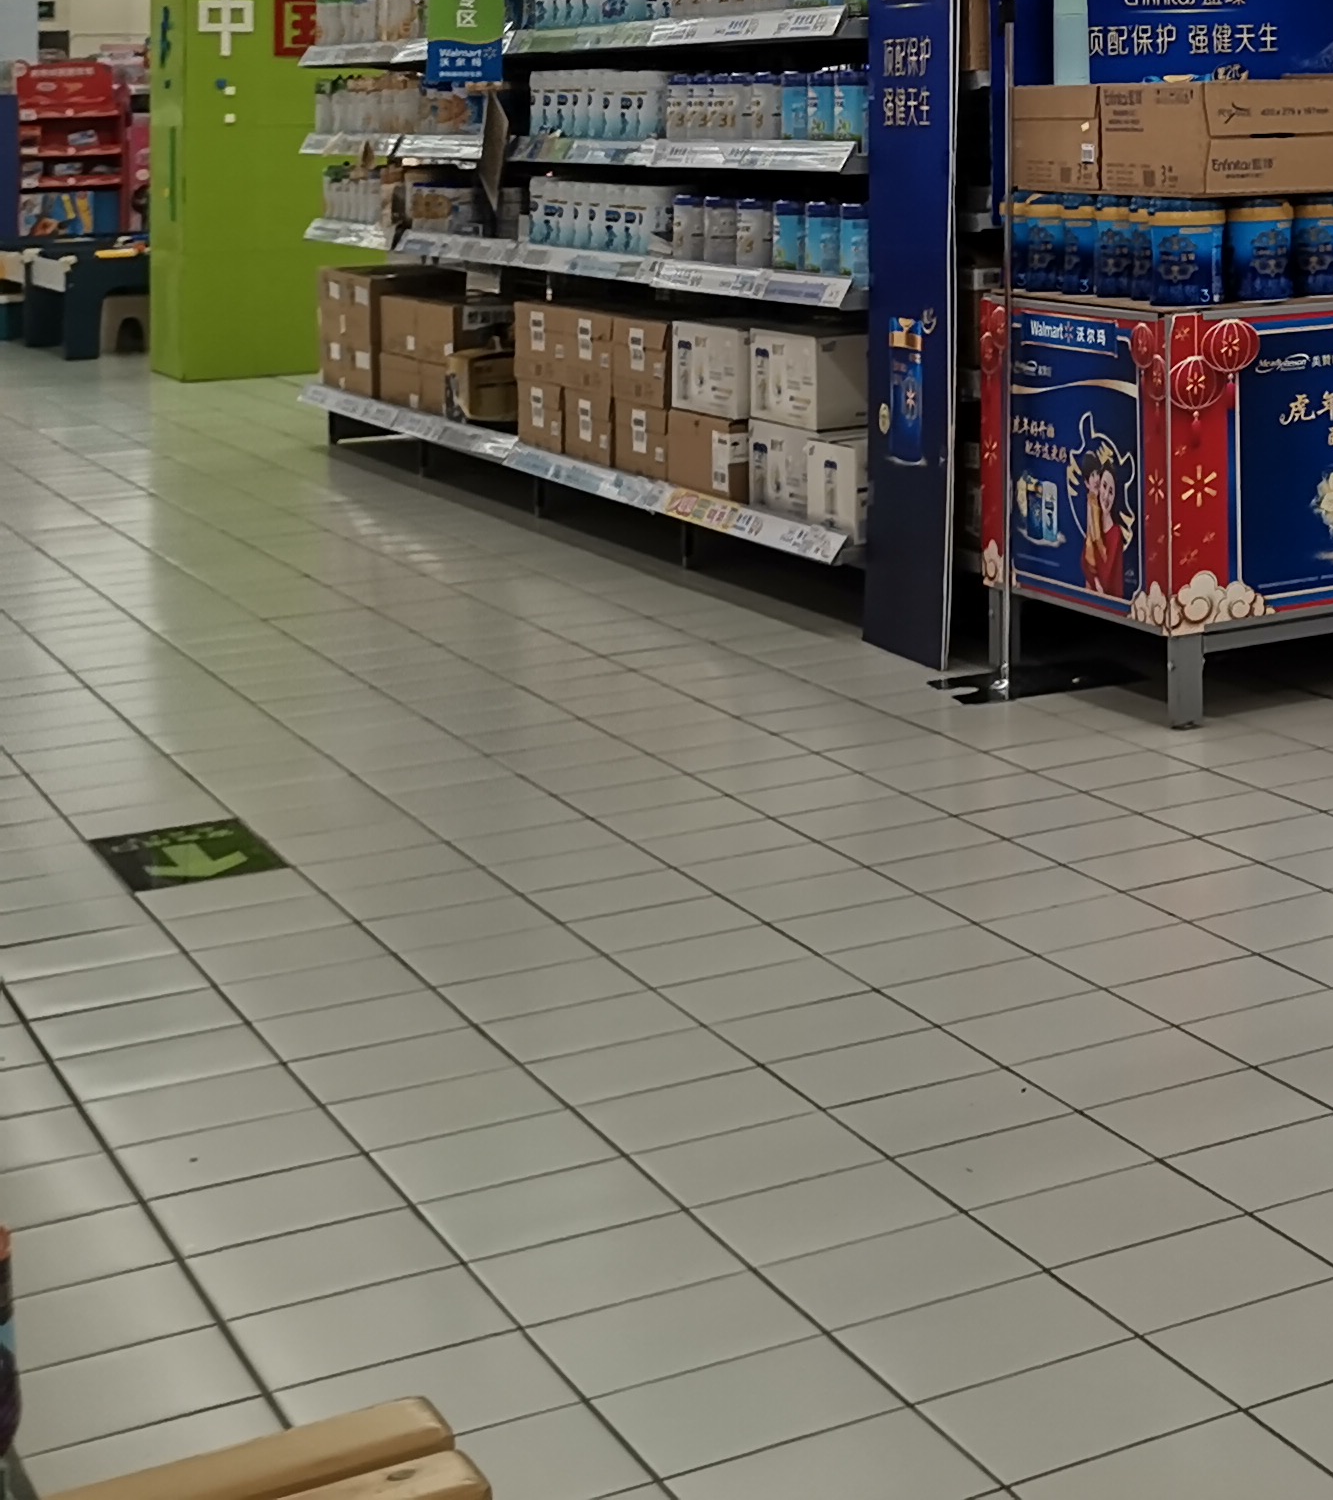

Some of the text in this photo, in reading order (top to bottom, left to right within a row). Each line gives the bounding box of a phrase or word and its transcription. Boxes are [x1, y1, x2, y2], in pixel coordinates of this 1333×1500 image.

[882, 34, 932, 77] 顶配保护
[1188, 22, 1279, 55] 强健天生
[882, 85, 932, 127] 强健天生
[1030, 319, 1107, 346] Walmart 沃尔玛
